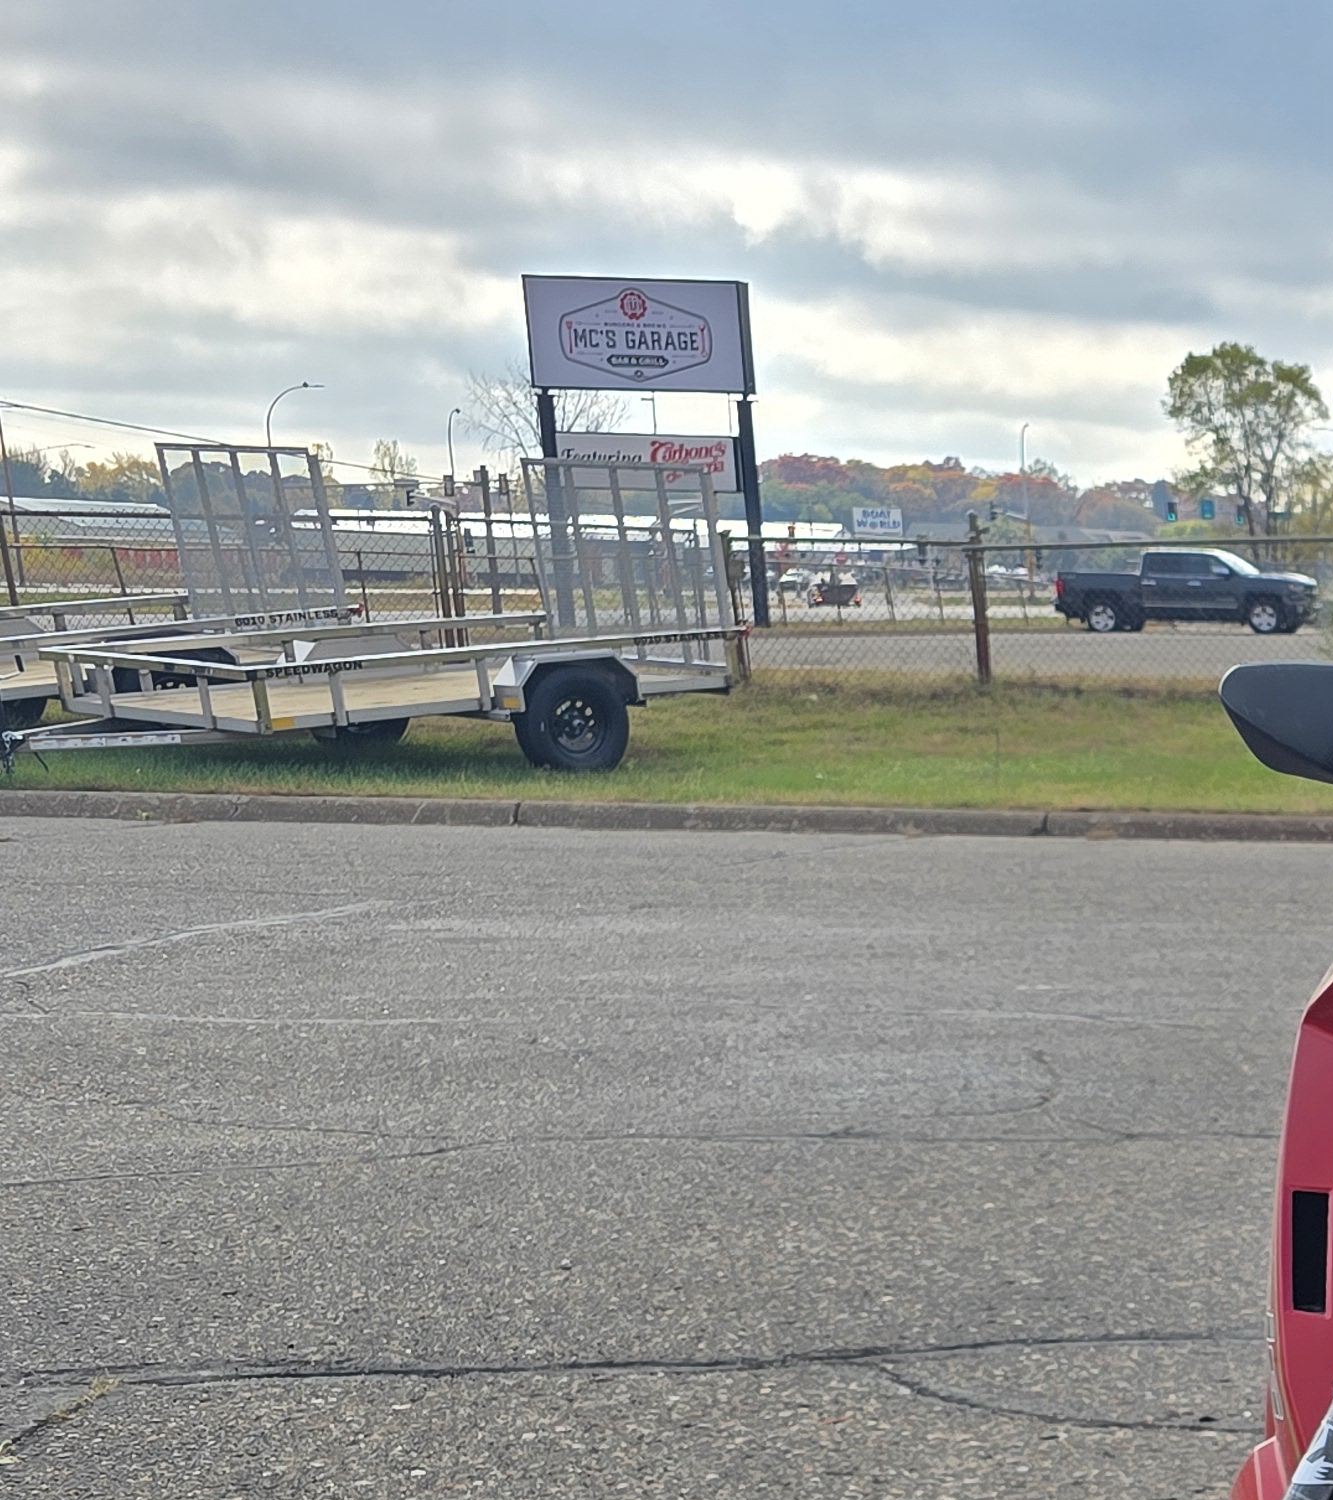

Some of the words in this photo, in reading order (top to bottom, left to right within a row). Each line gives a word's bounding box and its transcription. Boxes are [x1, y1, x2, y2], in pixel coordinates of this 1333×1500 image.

[573, 328, 616, 348] MC'S
[625, 330, 699, 351] GARAGE
[268, 609, 339, 625] STAINLESS
[265, 660, 363, 678] SPEEDWAGON
